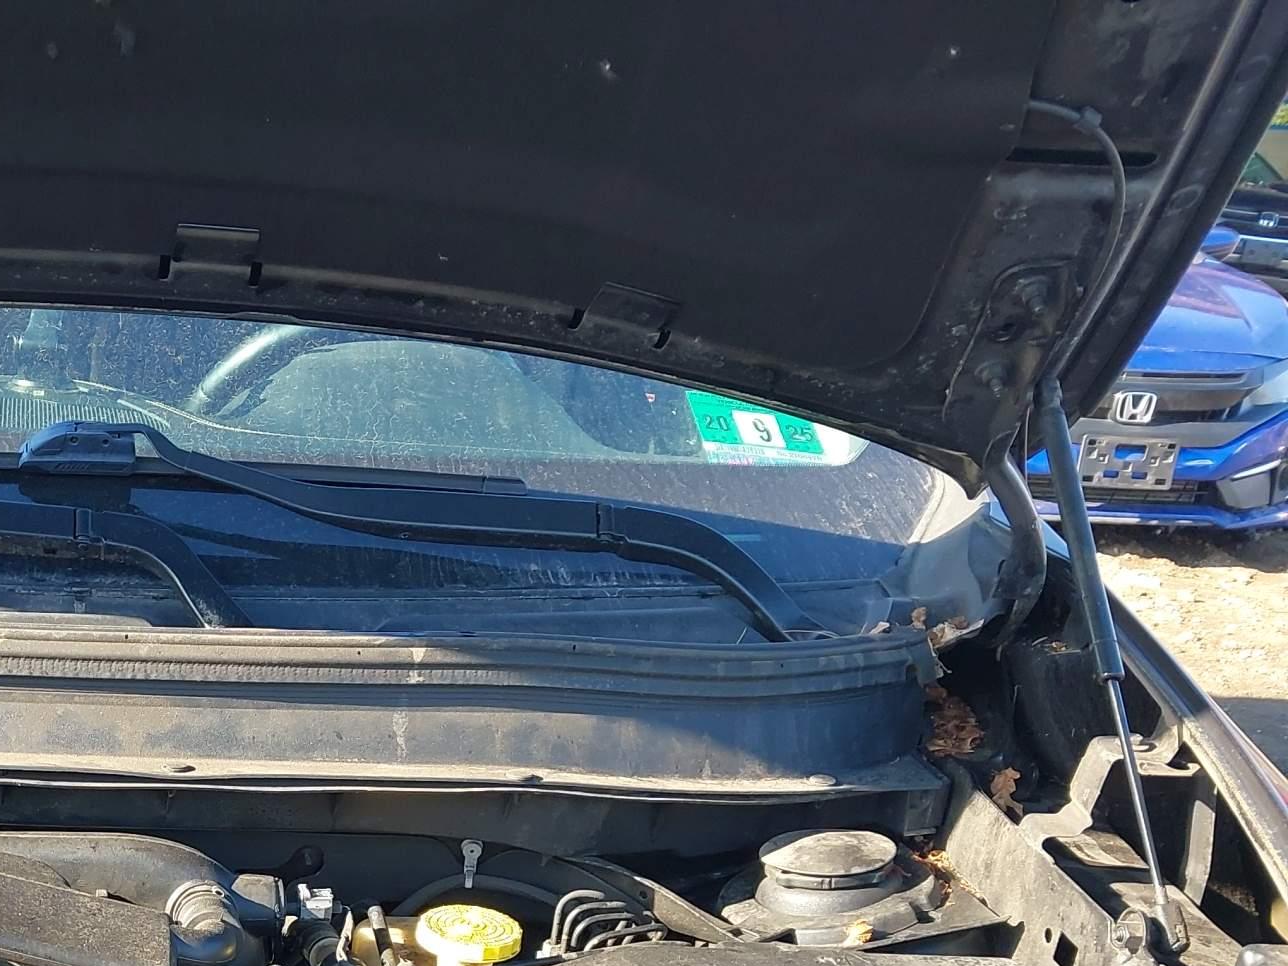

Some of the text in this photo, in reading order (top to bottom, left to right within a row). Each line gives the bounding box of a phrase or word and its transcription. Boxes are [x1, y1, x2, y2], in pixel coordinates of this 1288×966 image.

[703, 414, 813, 443] 20 9 25
